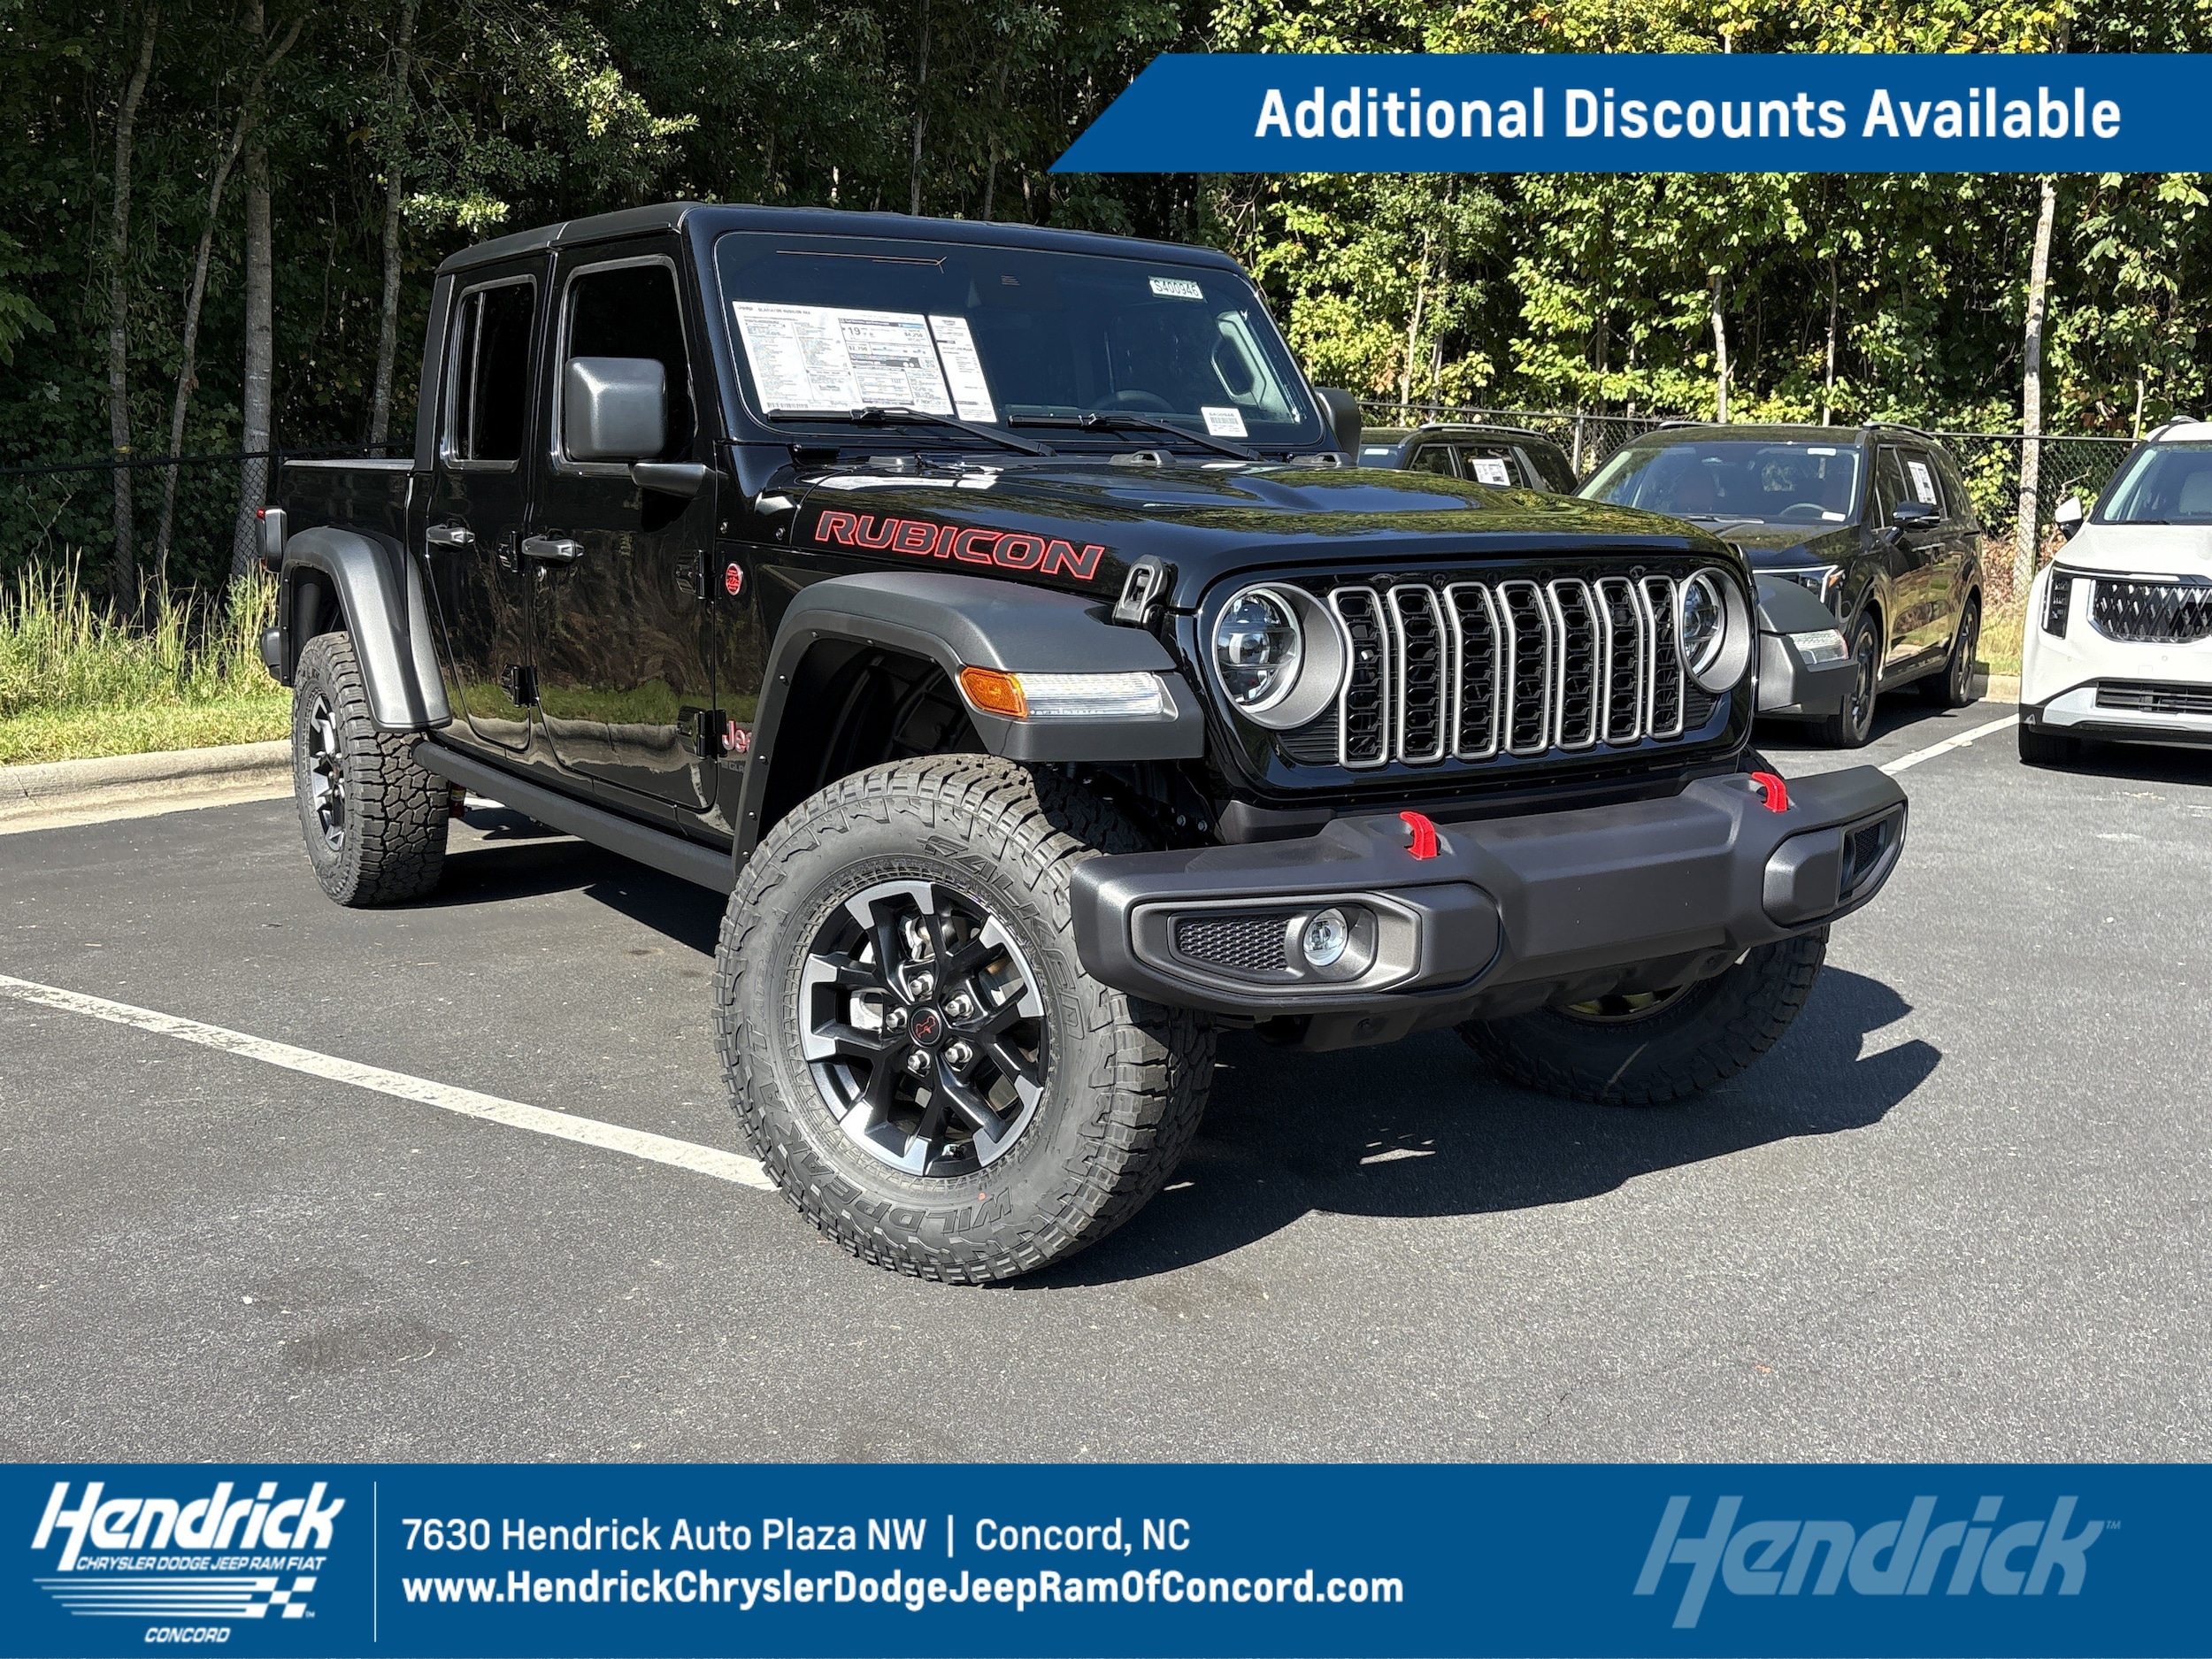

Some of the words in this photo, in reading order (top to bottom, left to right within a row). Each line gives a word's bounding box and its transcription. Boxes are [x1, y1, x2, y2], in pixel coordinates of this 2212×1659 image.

[847, 326, 862, 336] 19
[815, 510, 1105, 580] RUBICON
[779, 1118, 1014, 1236] WILDPEAK
